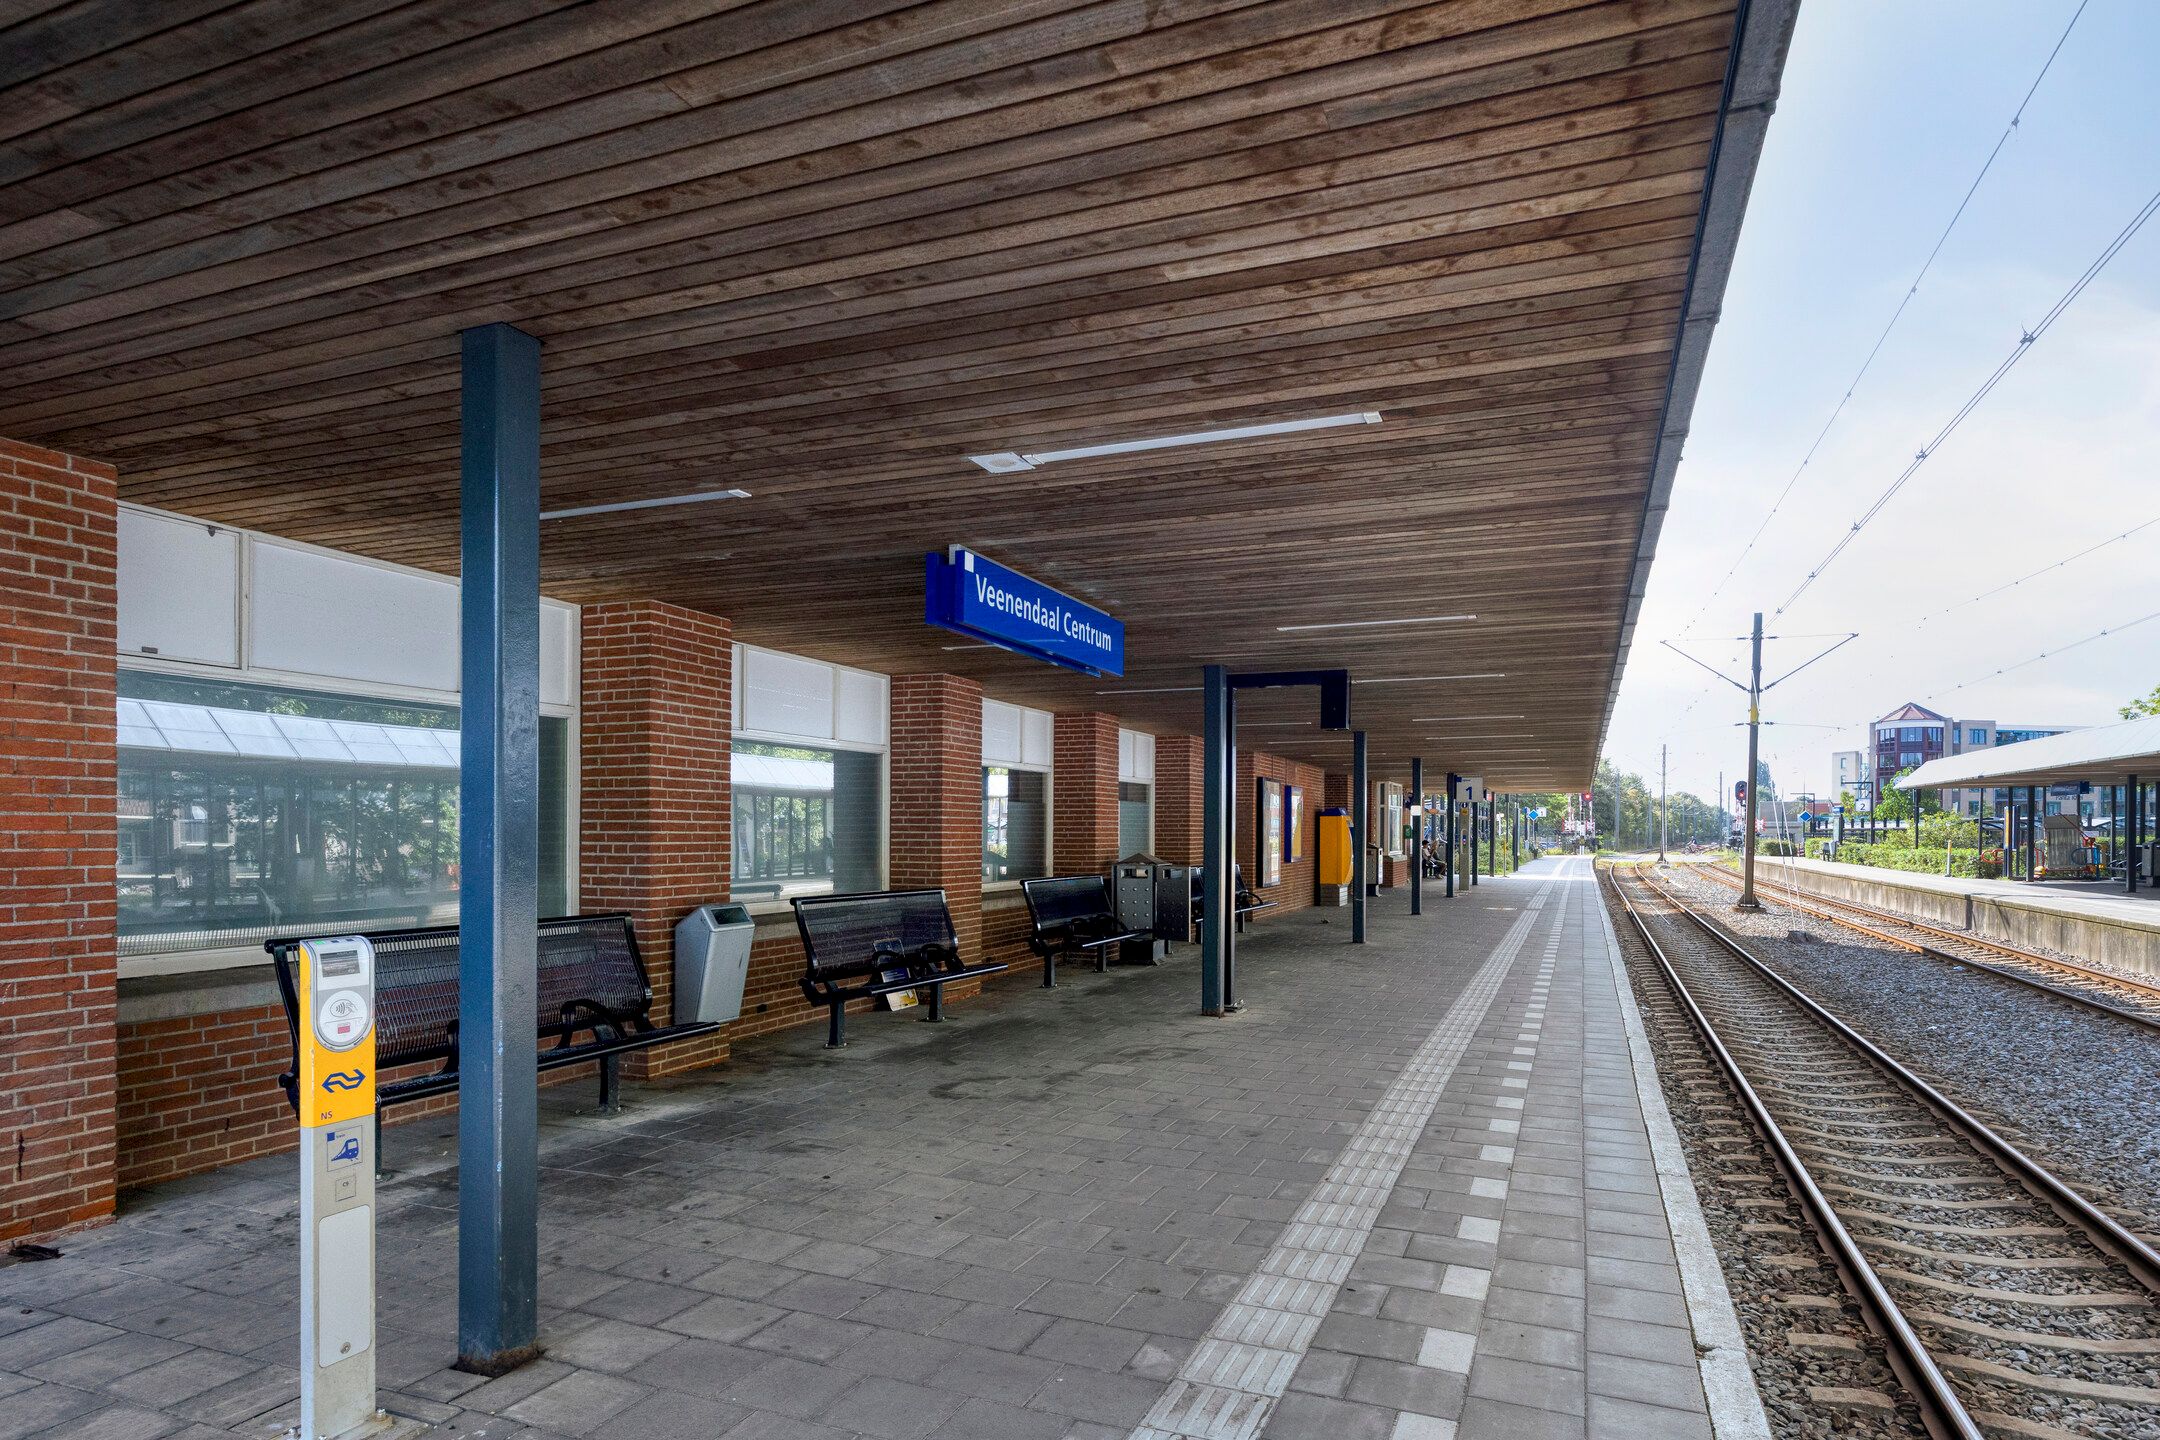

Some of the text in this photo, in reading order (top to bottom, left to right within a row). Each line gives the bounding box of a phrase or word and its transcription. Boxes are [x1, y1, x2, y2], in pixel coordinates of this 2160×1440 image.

[975, 574, 1112, 652] Veenendaal Centrum
[1465, 786, 1473, 800] 1
[1860, 803, 1866, 811] 2
[320, 1111, 333, 1120] NS
